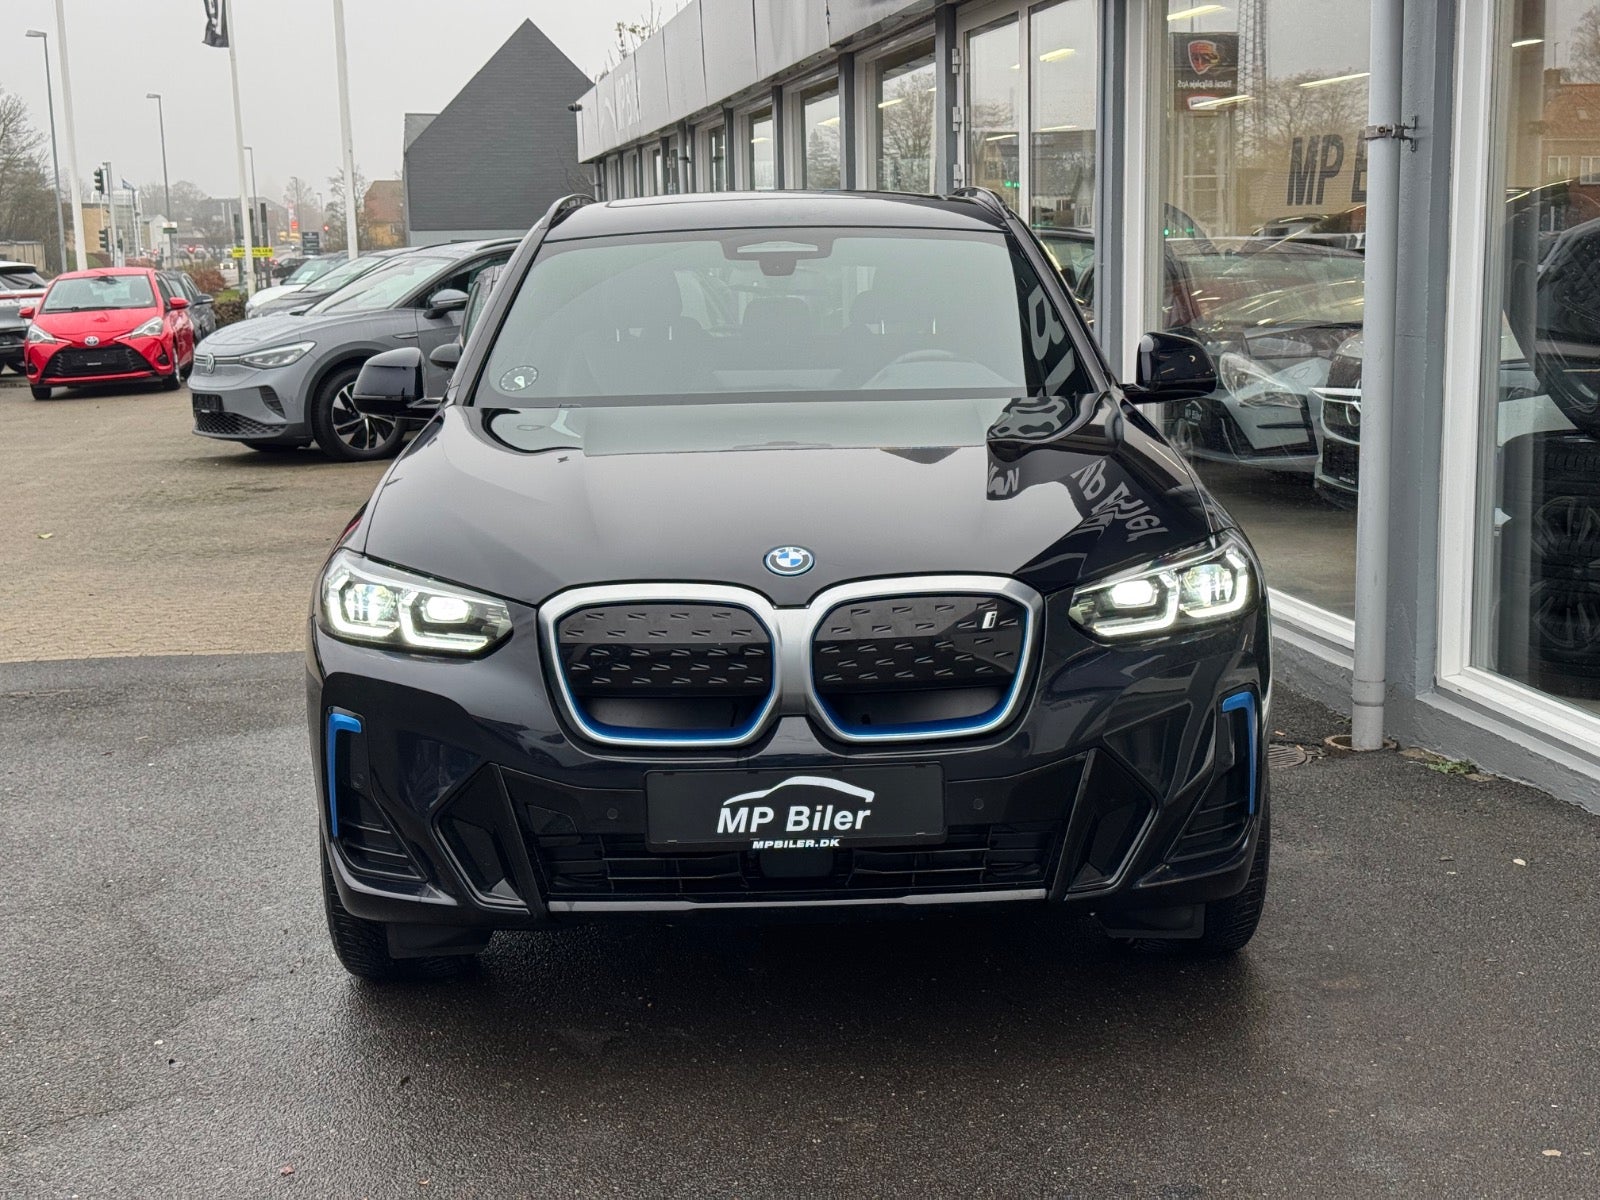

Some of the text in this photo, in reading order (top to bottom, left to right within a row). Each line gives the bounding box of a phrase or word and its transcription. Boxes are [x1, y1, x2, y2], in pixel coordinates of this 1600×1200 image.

[1286, 134, 1344, 206] MP
[716, 804, 872, 834] MP Biler
[752, 838, 841, 849] MPBILER.DK
